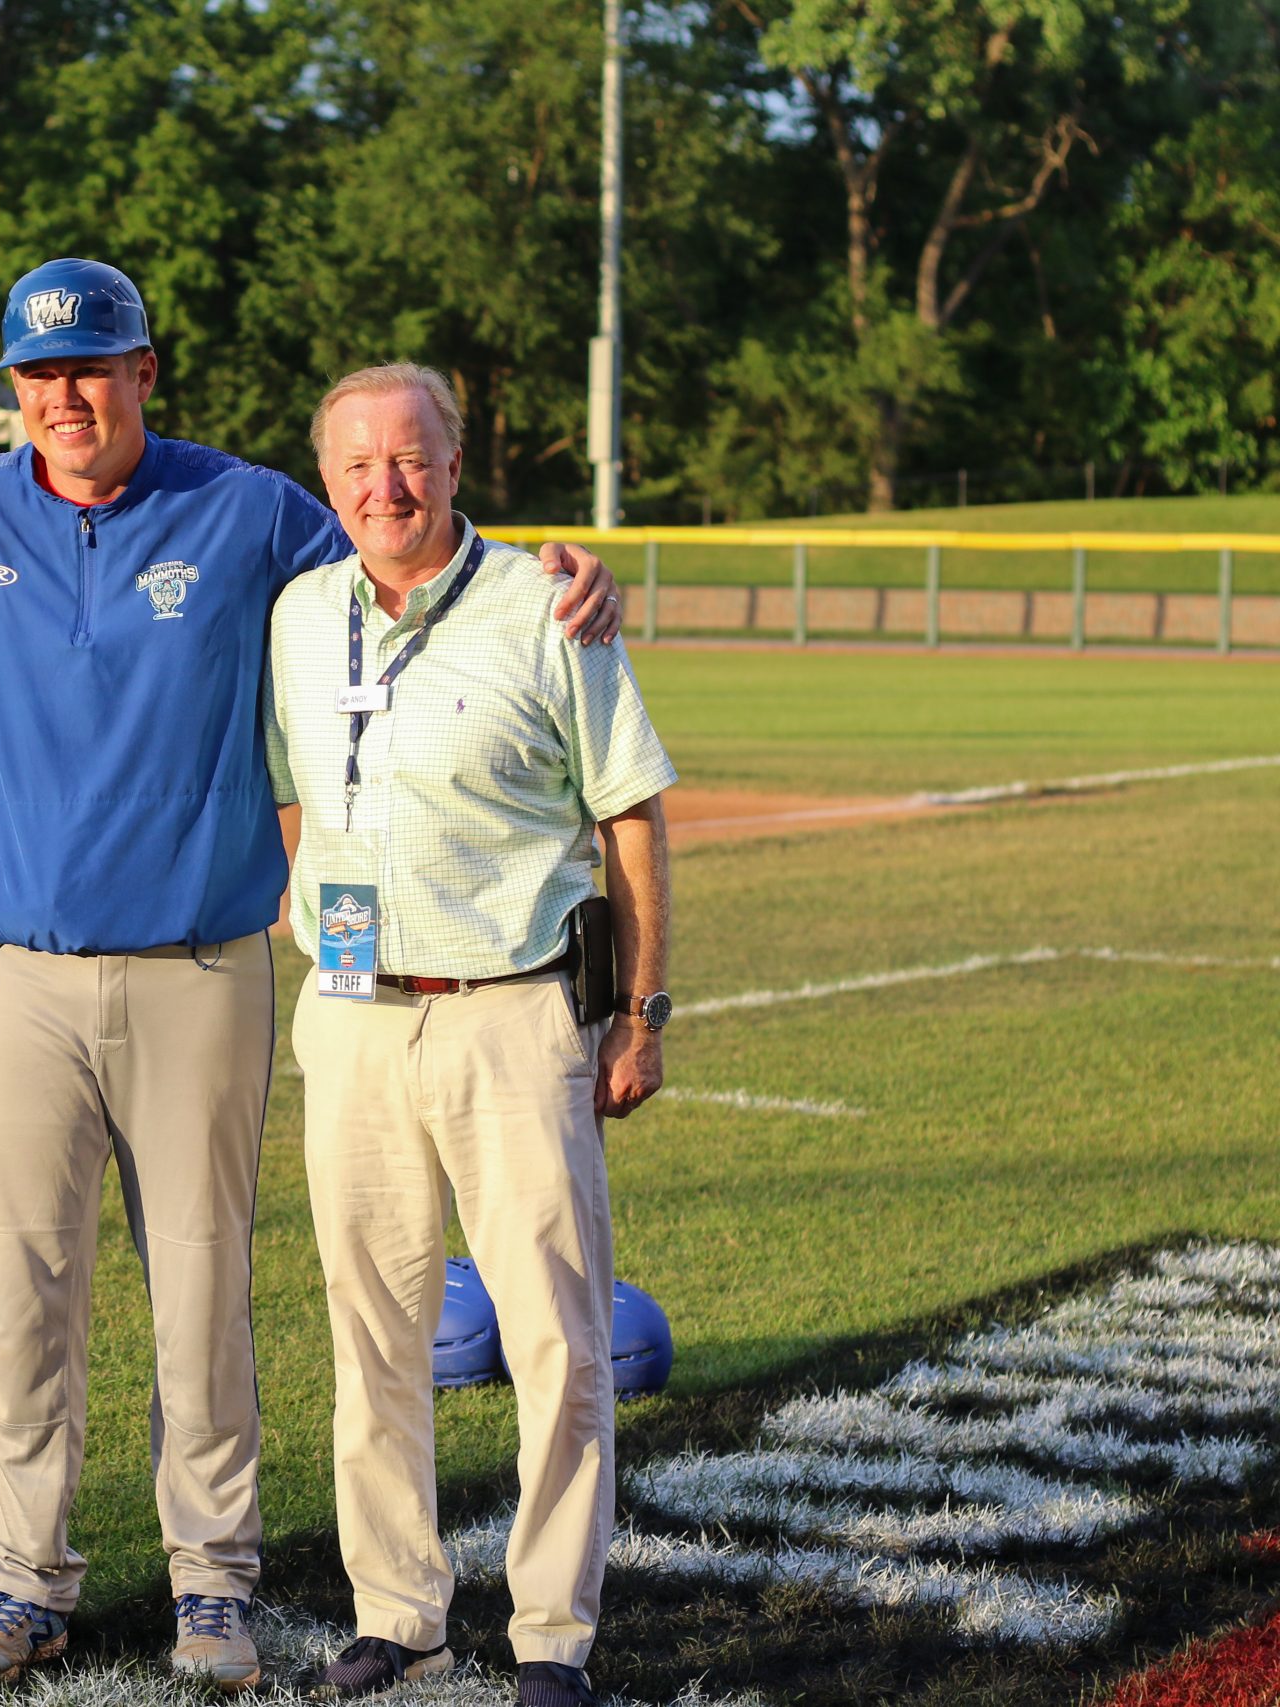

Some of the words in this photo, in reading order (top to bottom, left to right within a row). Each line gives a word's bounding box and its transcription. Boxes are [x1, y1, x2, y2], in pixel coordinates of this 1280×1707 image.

[28, 291, 77, 327] WM
[137, 566, 196, 589] MAMMOTHS
[326, 909, 353, 928] UNITED
[347, 910, 369, 926] SHORE
[331, 974, 361, 991] STAFF
